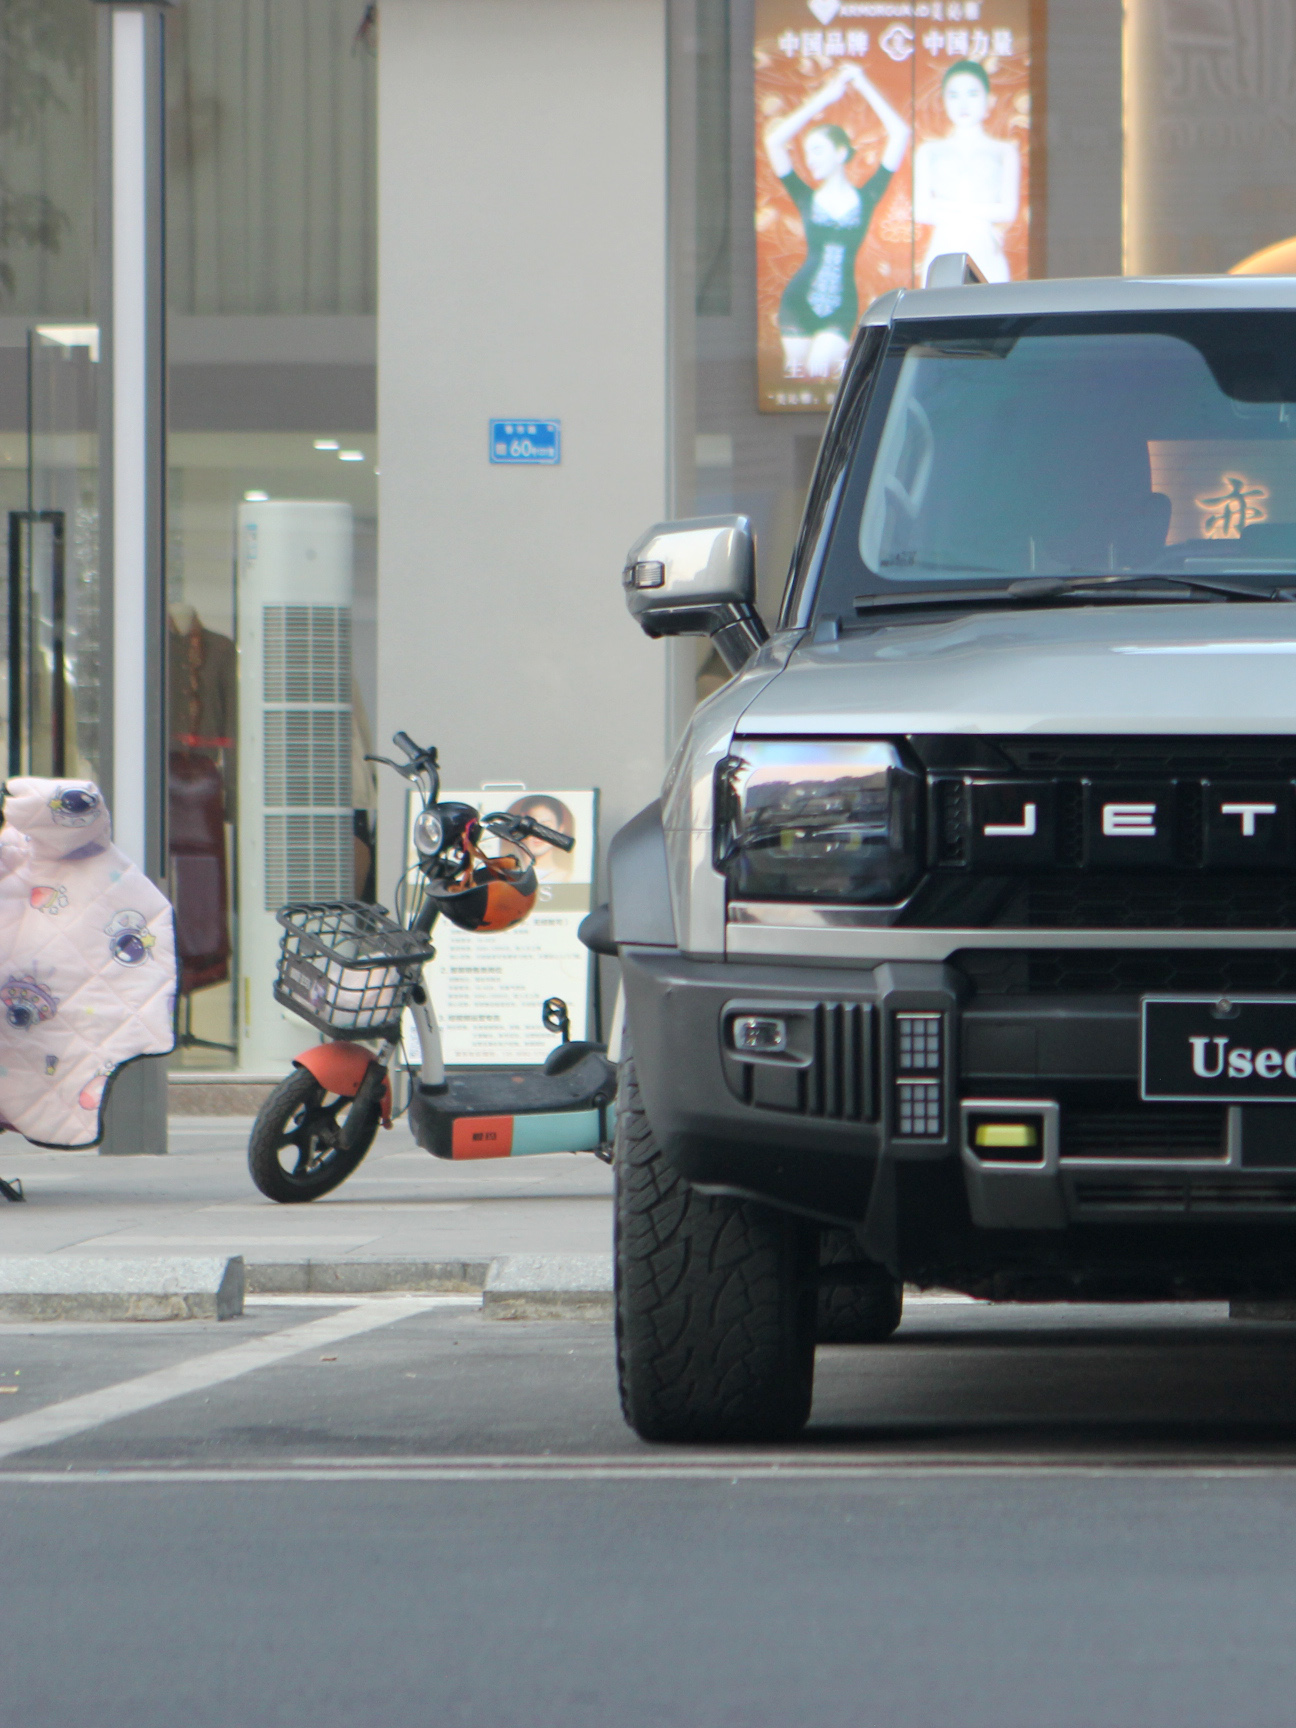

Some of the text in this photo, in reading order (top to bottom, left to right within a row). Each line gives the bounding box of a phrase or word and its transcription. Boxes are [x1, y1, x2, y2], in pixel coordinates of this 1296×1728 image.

[778, 28, 1014, 58] 中国品牌 中国力量
